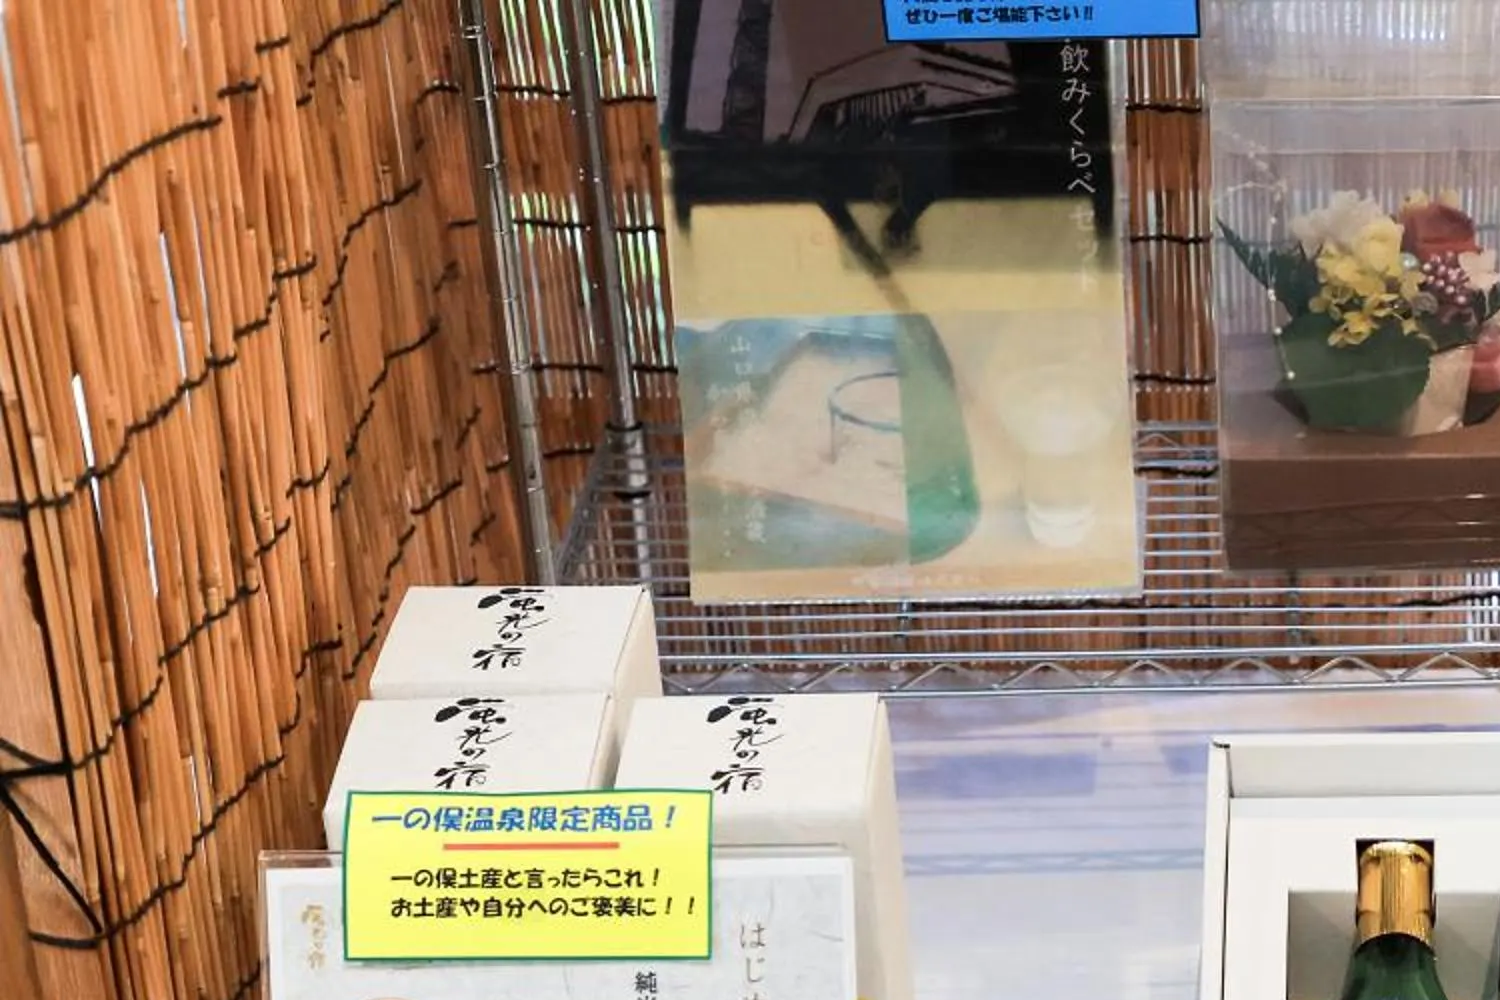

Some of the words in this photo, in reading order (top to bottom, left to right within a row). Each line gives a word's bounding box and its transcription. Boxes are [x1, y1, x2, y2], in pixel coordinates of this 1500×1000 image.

[371, 804, 677, 833] 一の俣温泉限定商品！
[390, 867, 661, 890] 一の俣土産と言ったらこれ！
